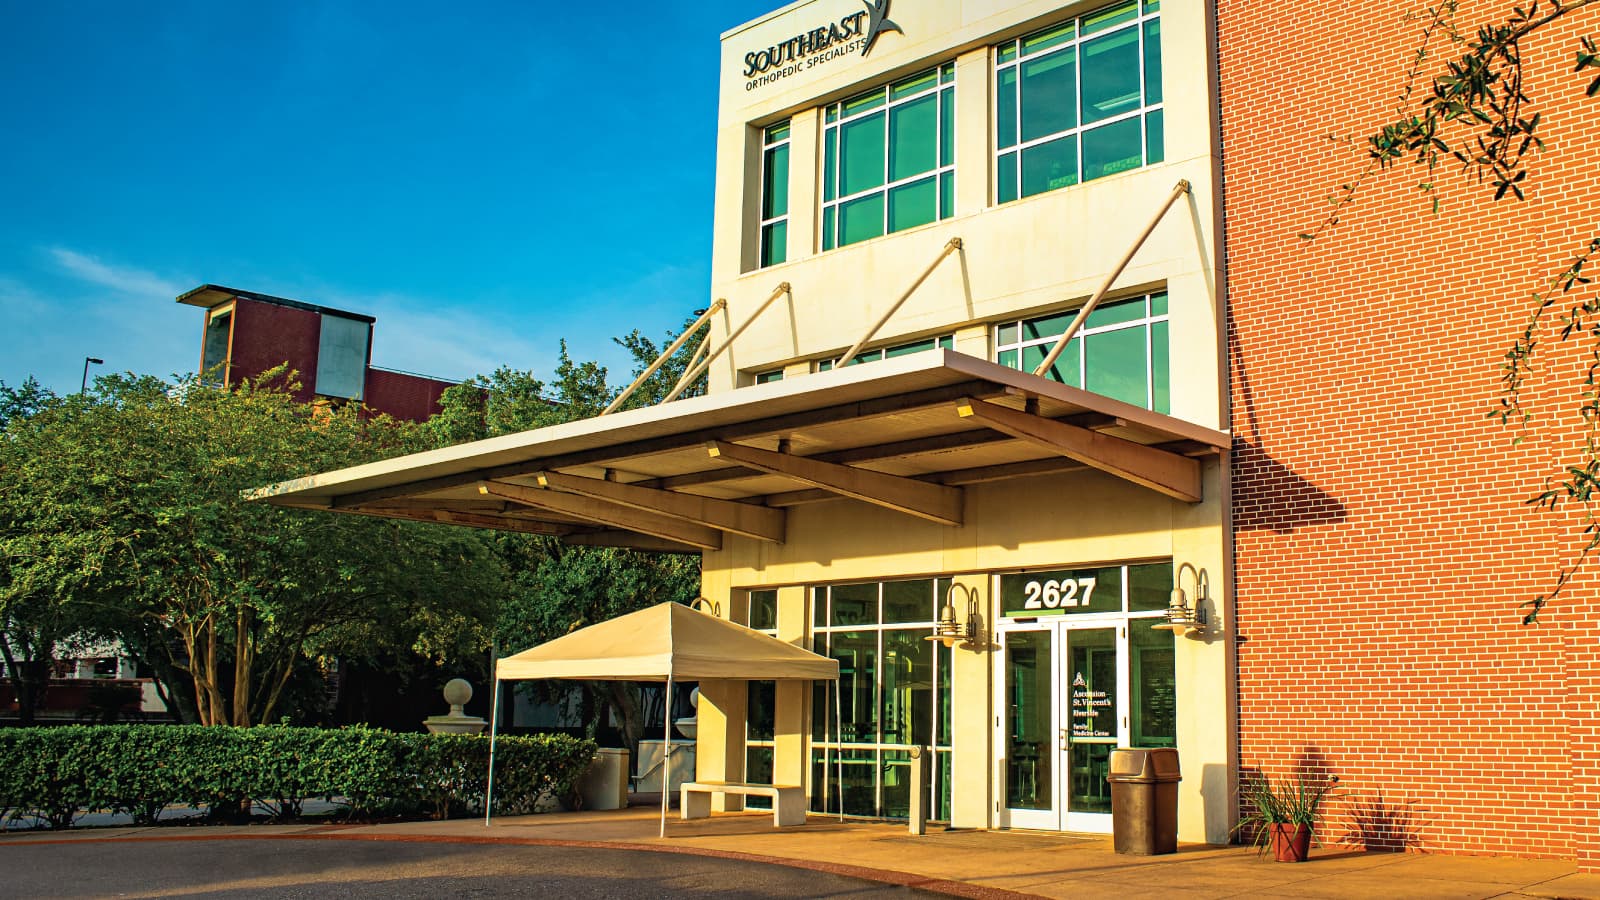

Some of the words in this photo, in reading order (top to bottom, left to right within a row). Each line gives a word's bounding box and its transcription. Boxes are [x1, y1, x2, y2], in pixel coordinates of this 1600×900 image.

[743, 10, 867, 77] SOUTHEAST
[745, 61, 803, 92] ORTHOPEDIC
[806, 37, 867, 70] SPECIALISTS
[1024, 577, 1096, 610] 2627
[1073, 690, 1106, 698] Ascension
[1073, 698, 1082, 706] St.
[1082, 698, 1111, 706] Vincent's
